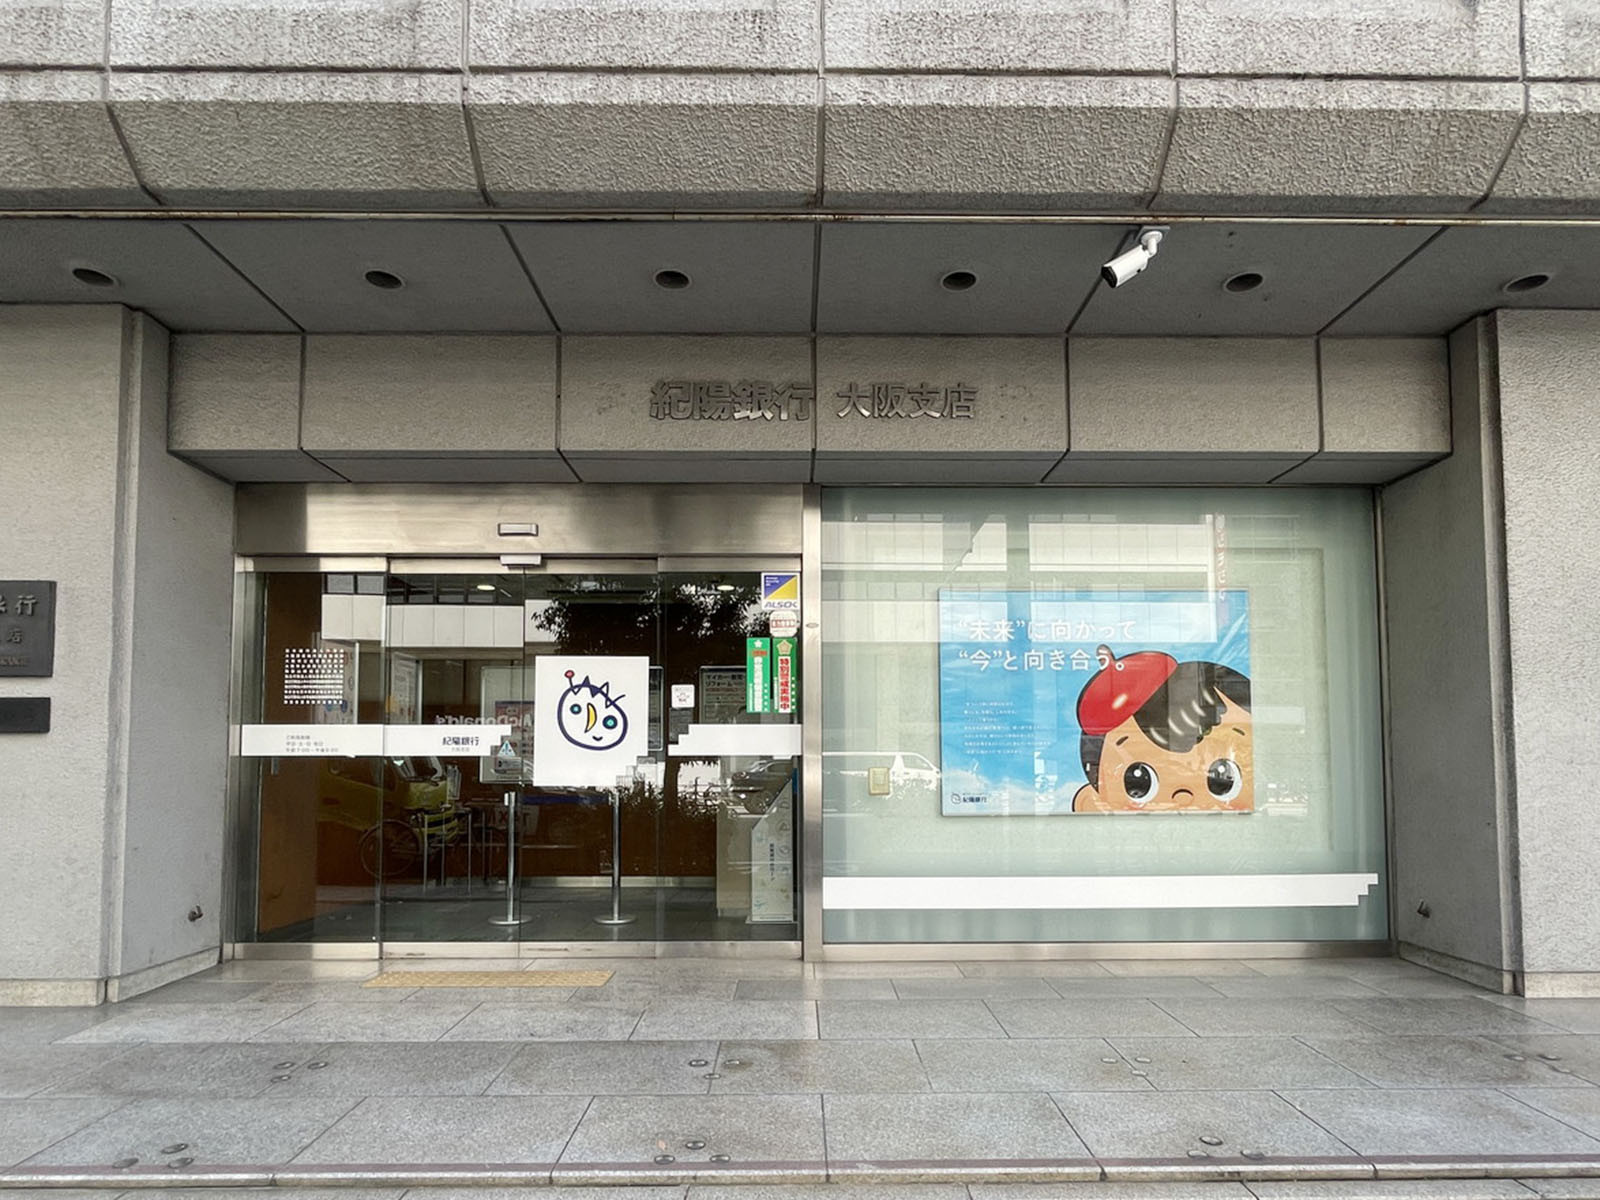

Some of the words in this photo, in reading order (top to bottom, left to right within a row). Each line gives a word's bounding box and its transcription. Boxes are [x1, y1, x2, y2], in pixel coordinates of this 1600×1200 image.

[650, 379, 815, 421] 紀陽銀行
[836, 383, 978, 419] 大阪支店
[764, 601, 798, 609] ALSOK
